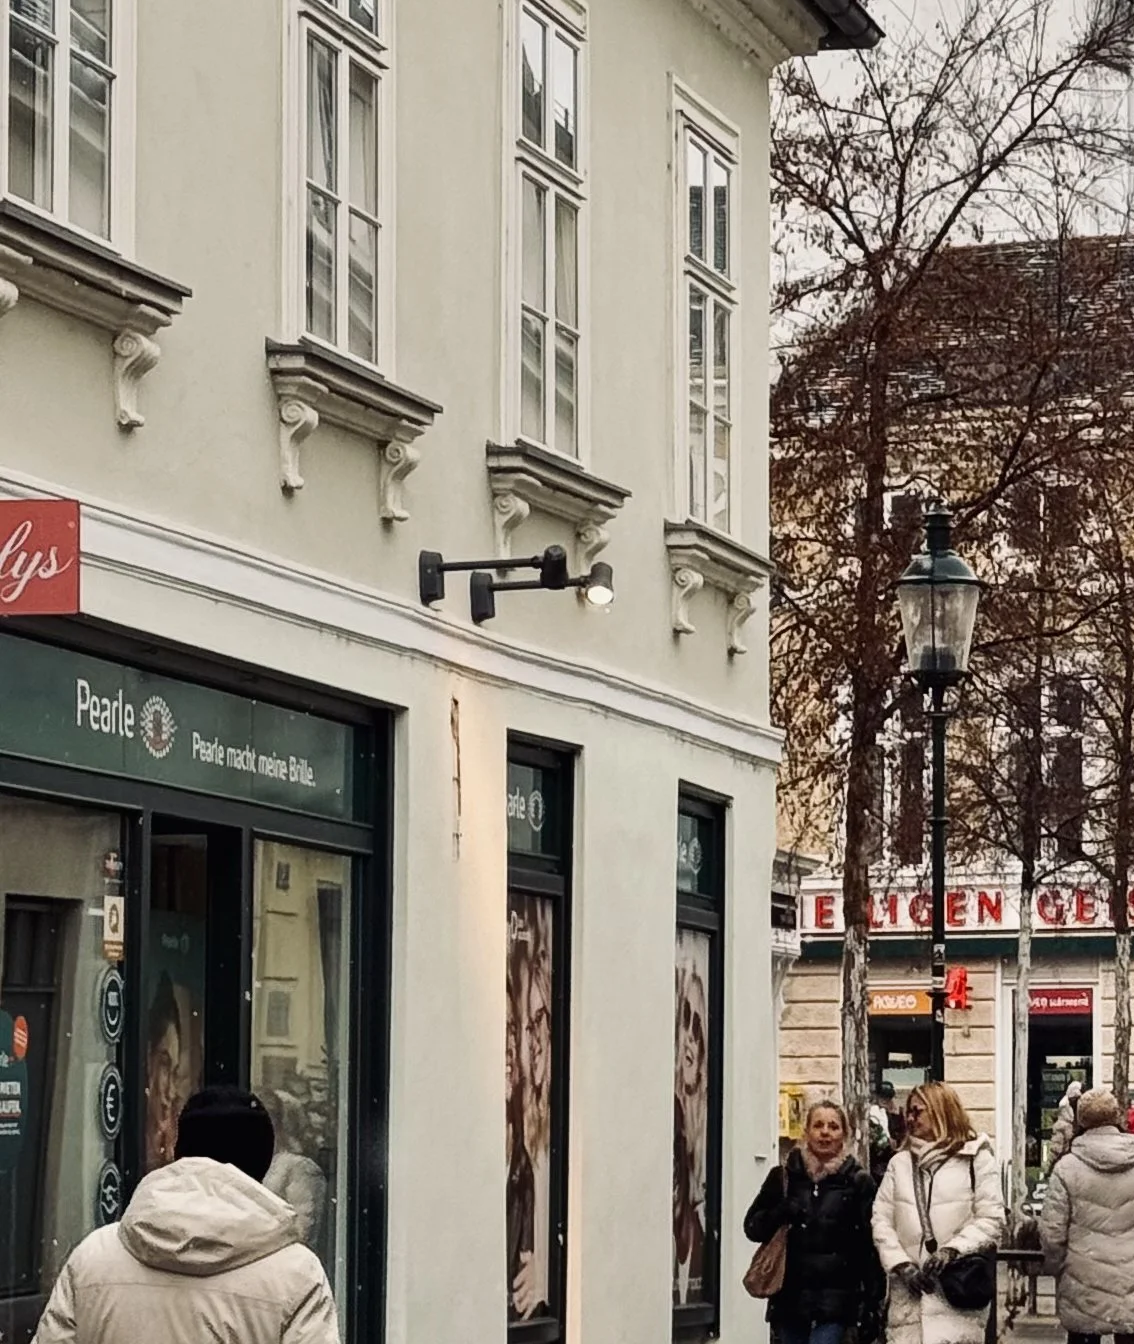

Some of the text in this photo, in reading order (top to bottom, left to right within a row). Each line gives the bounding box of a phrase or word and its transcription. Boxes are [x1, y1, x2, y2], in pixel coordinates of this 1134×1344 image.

[76, 677, 135, 739] Pearle
[192, 731, 224, 768] Pearle
[226, 745, 257, 774] macht
[258, 752, 288, 781] meine
